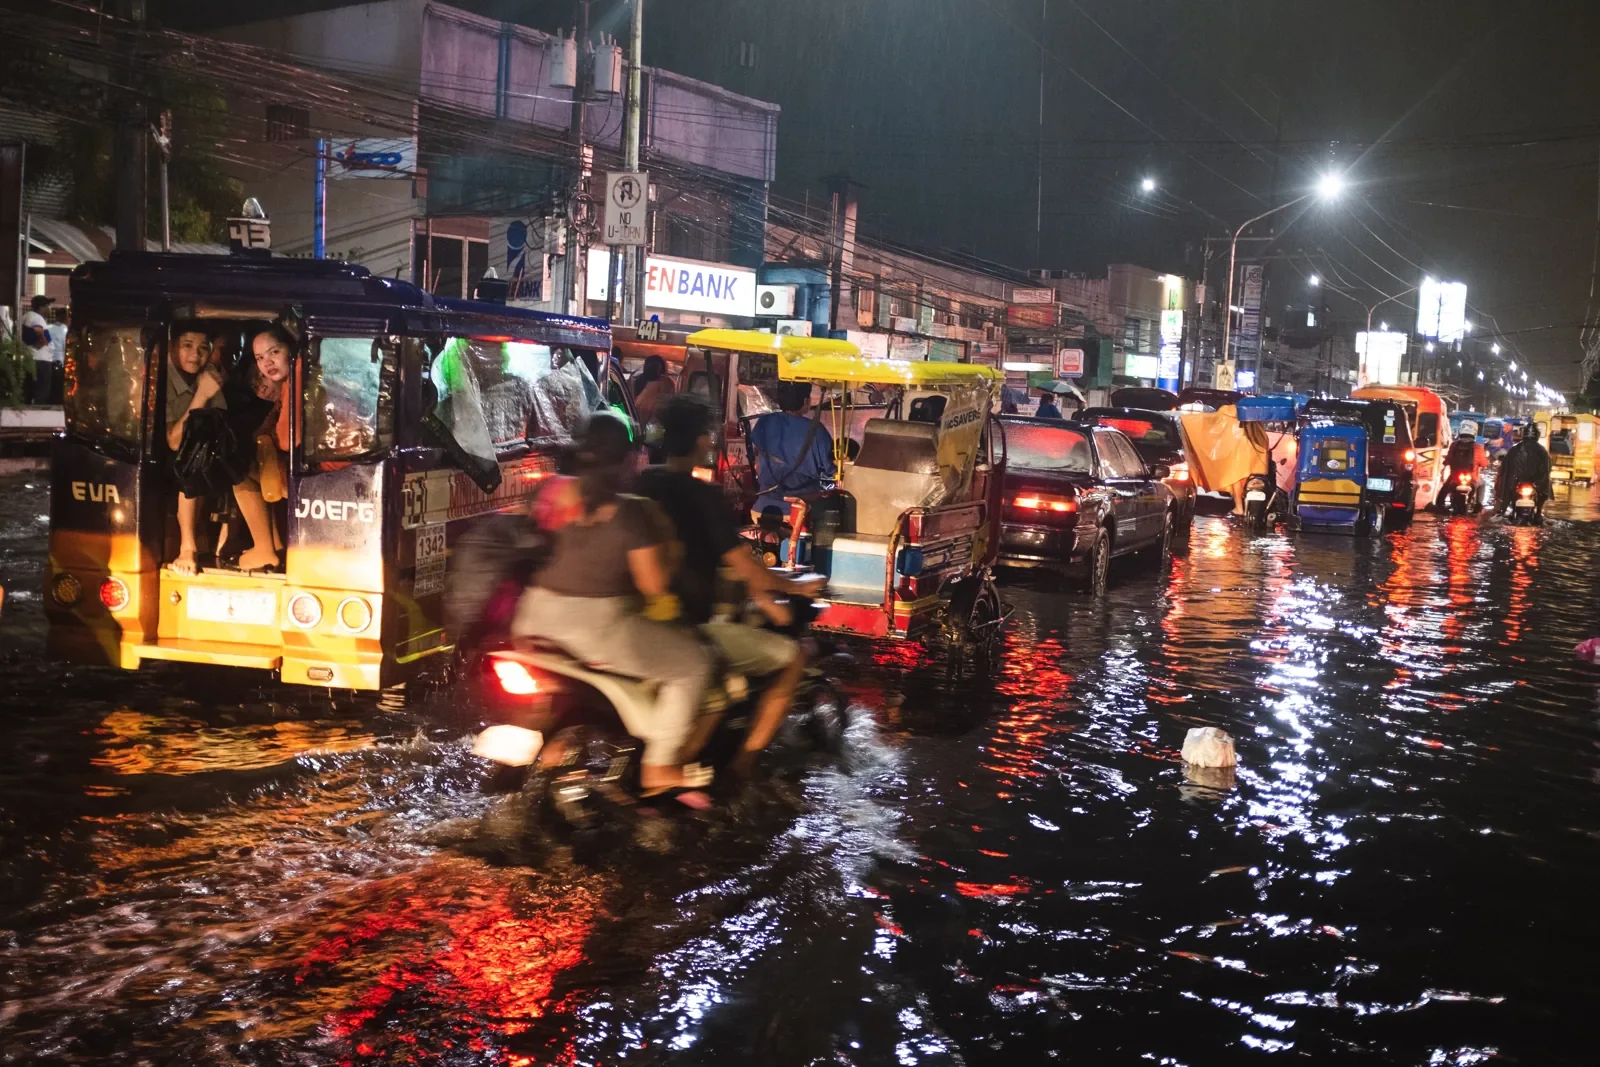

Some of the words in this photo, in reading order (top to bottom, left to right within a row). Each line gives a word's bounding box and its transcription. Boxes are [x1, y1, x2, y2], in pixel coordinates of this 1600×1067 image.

[619, 211, 632, 225] NO
[229, 223, 272, 249] 43
[647, 265, 738, 300] ENBANK
[72, 481, 121, 504] EVA
[419, 535, 444, 557] 1342
